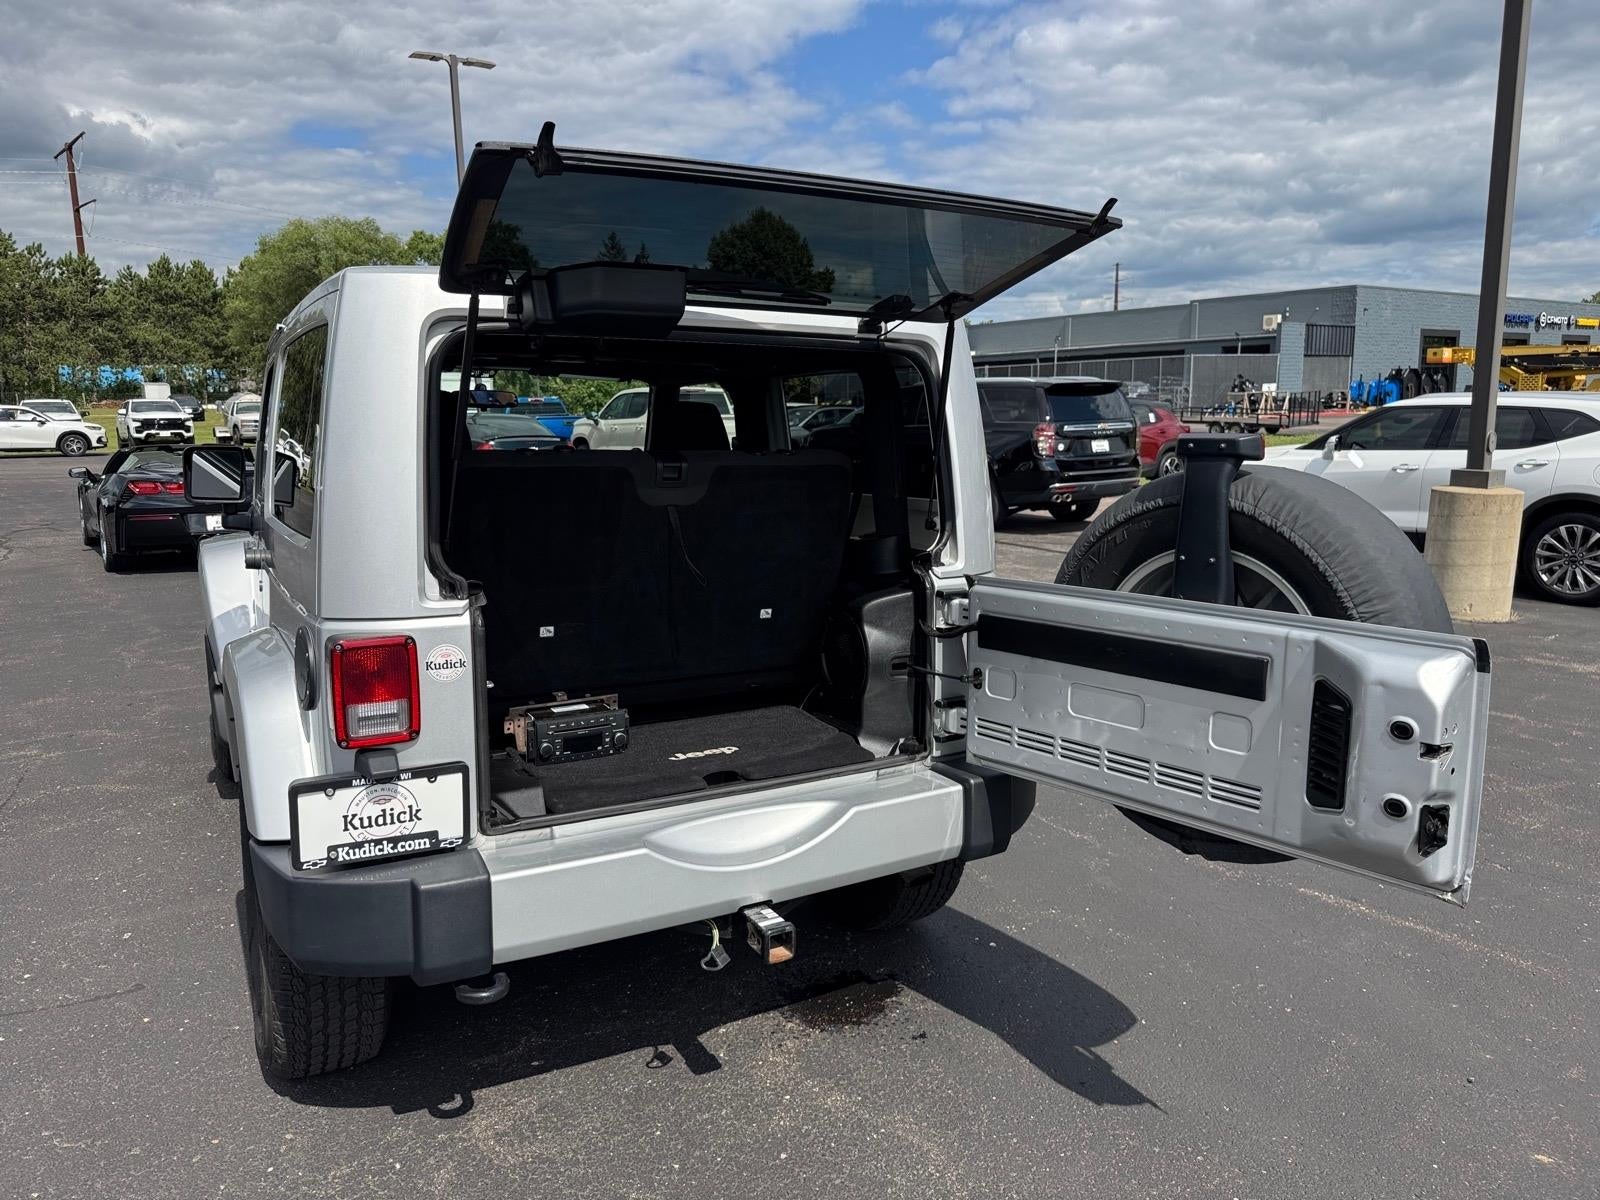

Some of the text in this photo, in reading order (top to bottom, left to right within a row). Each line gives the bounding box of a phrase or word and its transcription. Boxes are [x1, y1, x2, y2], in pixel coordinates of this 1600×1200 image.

[425, 659, 467, 671] Kudick
[668, 746, 739, 761] Jeep
[400, 772, 412, 780] WI
[342, 805, 422, 832] Kudick
[337, 838, 430, 861] Kudick.com
